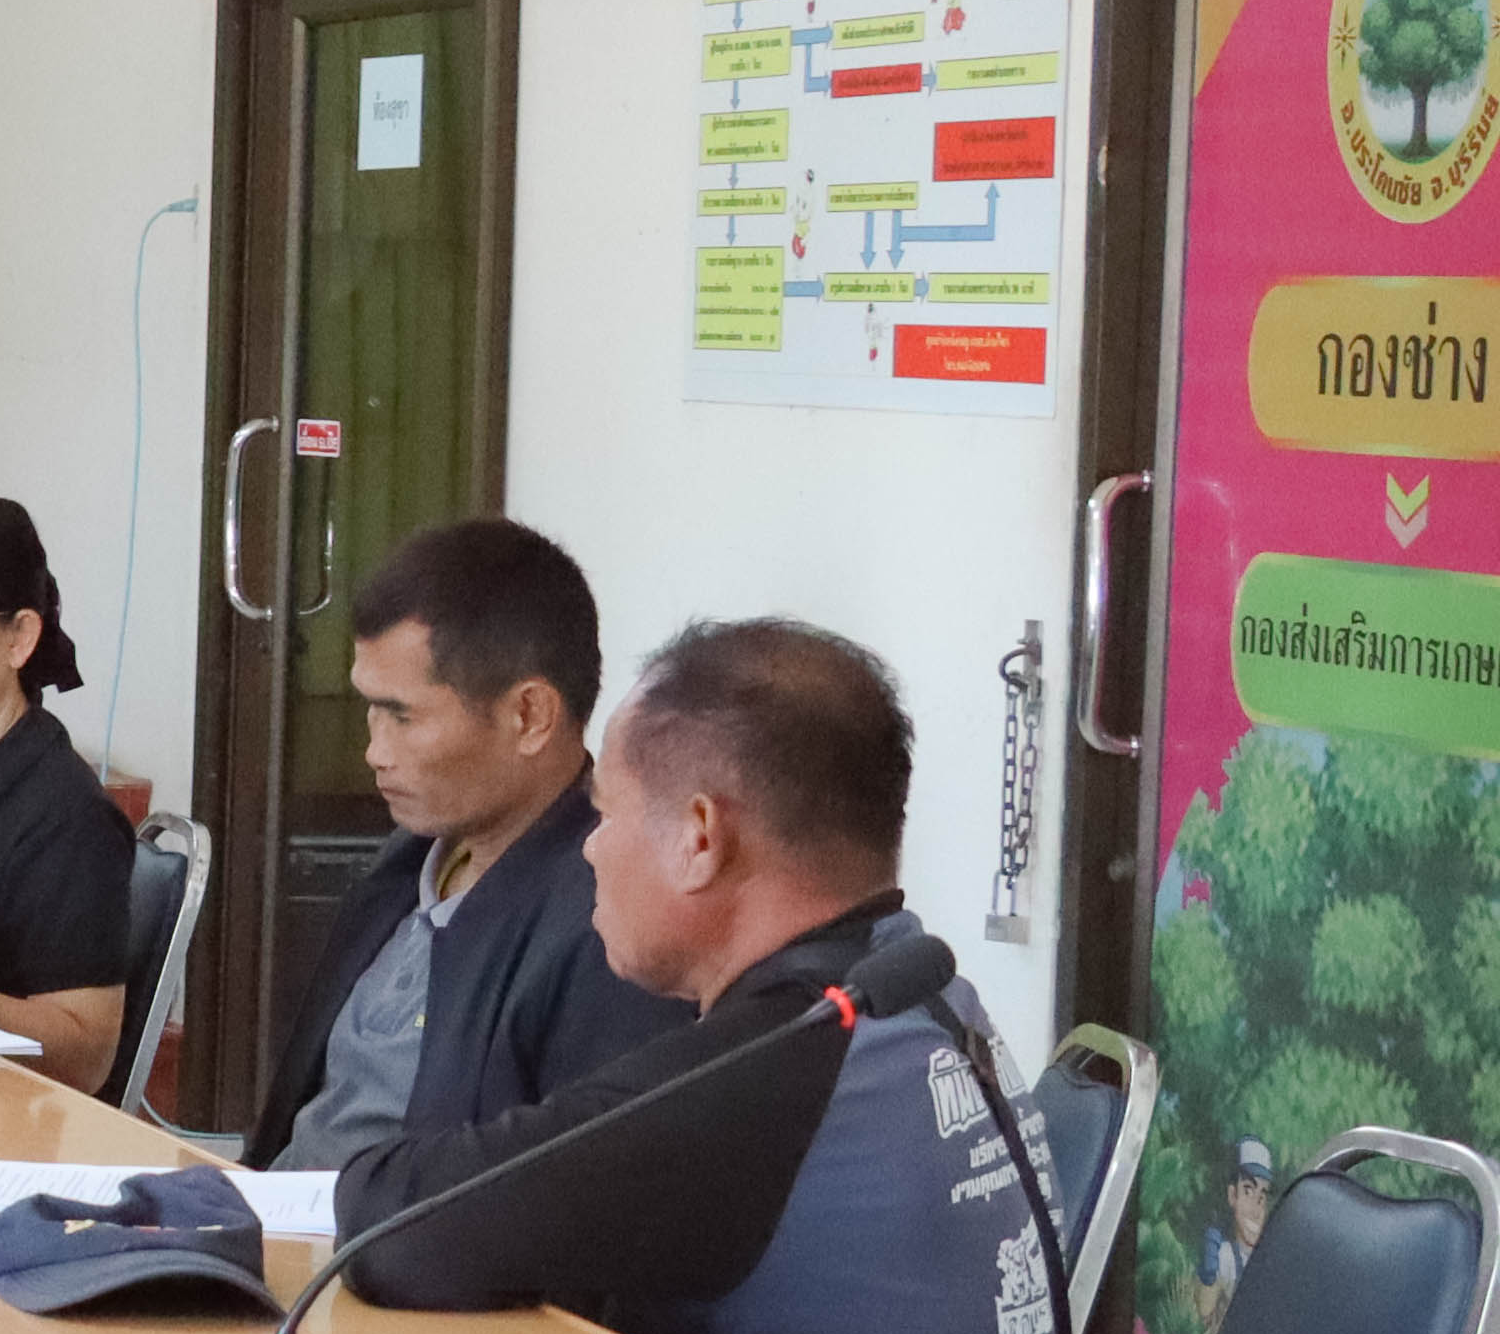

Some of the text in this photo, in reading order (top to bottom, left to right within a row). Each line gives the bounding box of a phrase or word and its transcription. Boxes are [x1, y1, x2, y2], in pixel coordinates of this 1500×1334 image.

[1316, 301, 1488, 403] กองช่าง
[1240, 602, 1500, 688] กองส่งเสริมการเกษ
